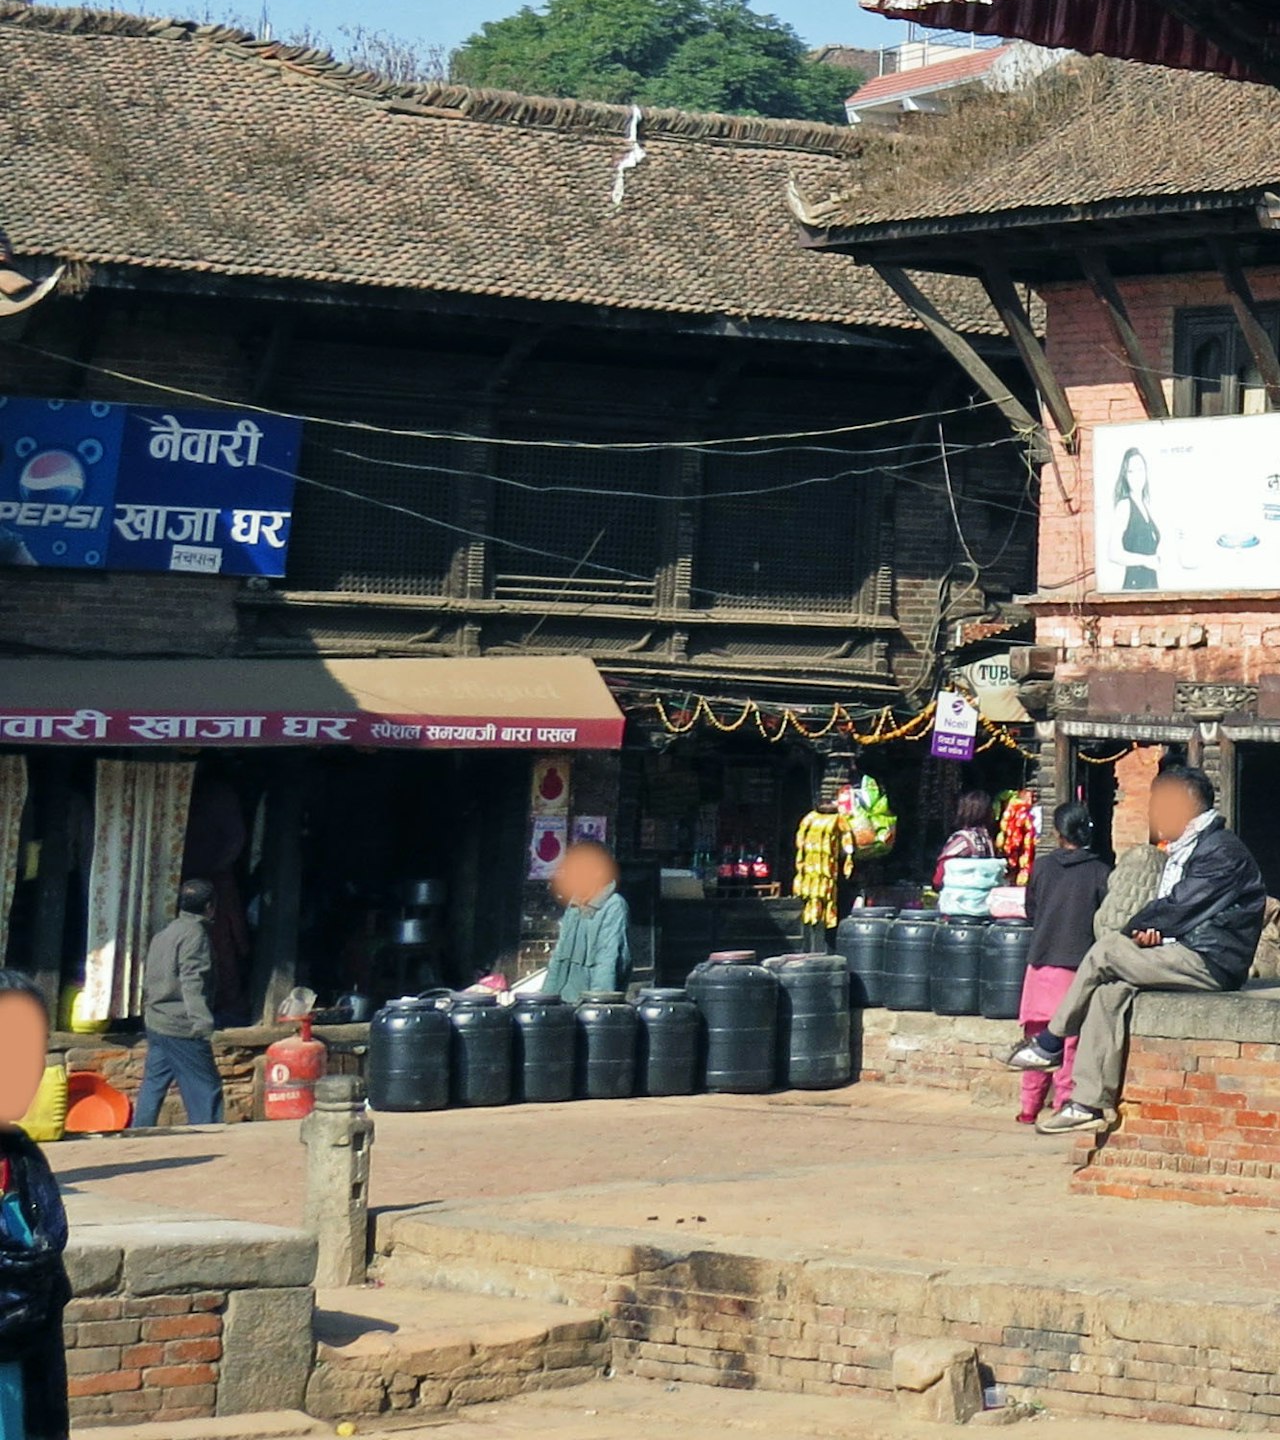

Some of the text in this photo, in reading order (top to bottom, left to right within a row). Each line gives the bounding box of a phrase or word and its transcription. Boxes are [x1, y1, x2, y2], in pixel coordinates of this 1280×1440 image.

[148, 414, 264, 468] नेवारी
[0, 500, 105, 529] PEPSI
[113, 503, 292, 548] खाजा घर
[0, 709, 113, 740] वारी
[129, 716, 267, 740] खाजा
[281, 716, 357, 741] घर
[537, 727, 578, 743] पसल
[944, 717, 969, 729] Ncell
